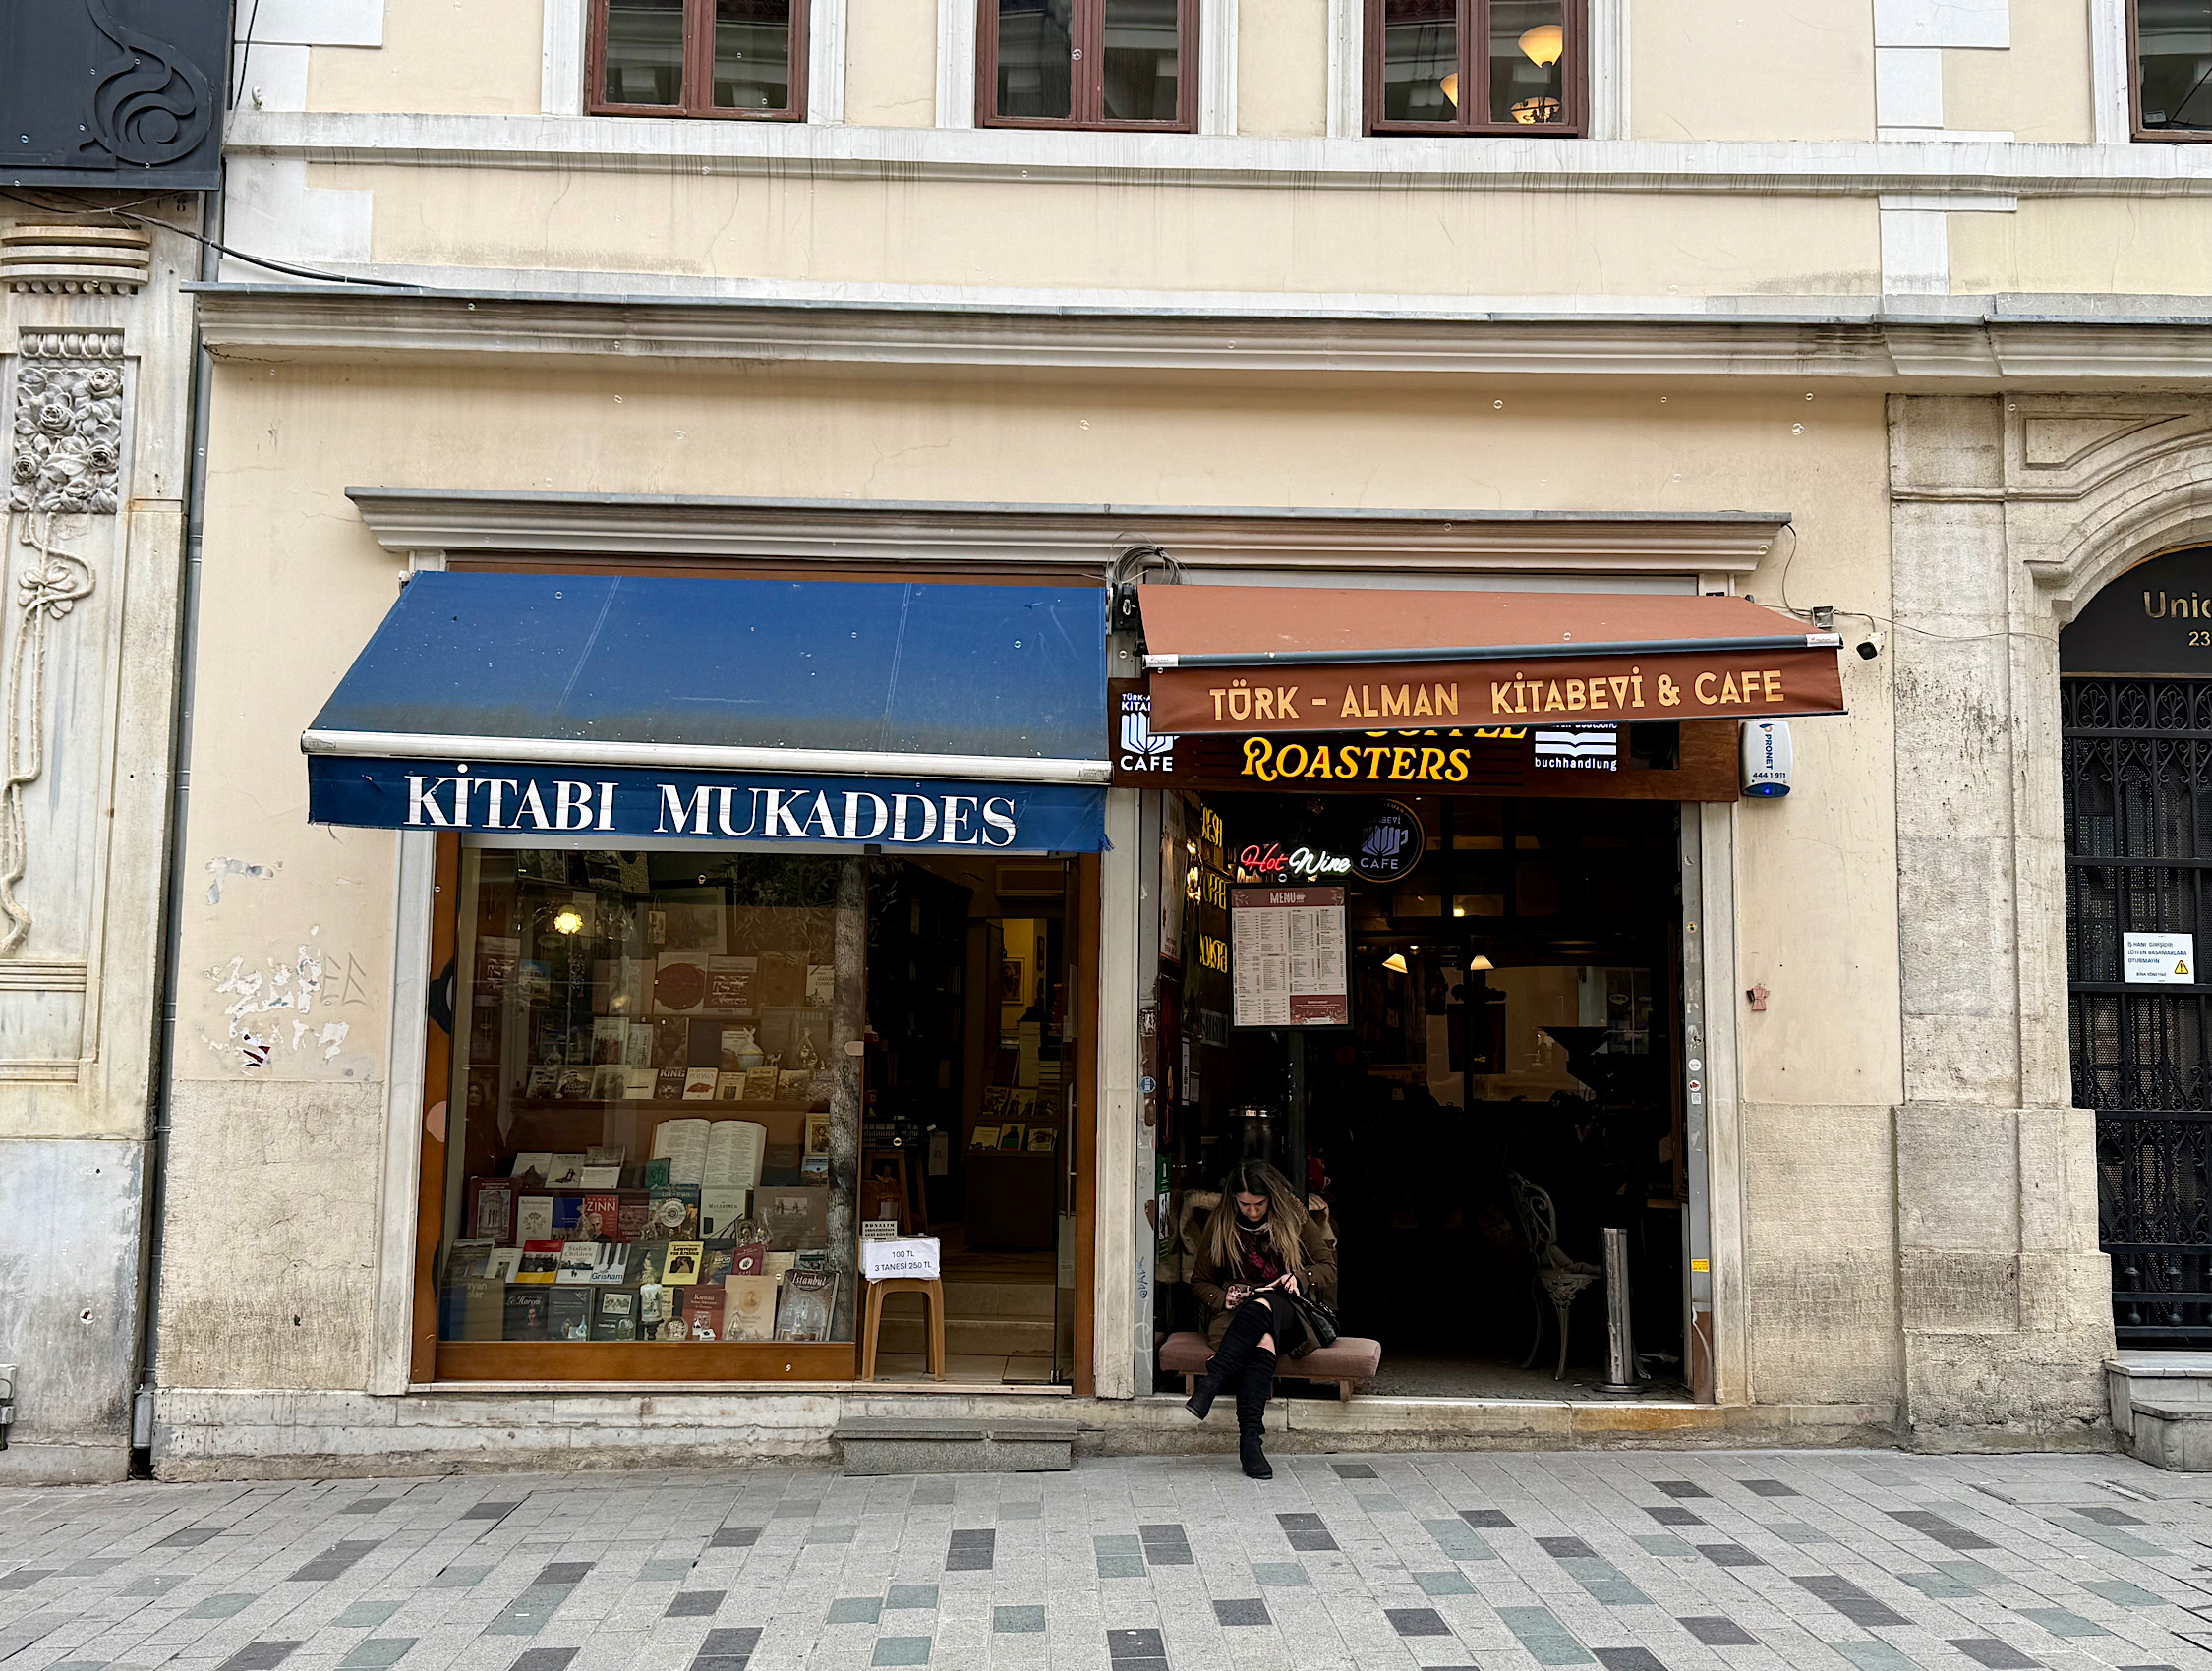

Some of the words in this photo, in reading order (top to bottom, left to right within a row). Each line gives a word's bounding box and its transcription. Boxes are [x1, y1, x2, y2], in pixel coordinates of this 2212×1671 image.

[2188, 631, 2212, 646] 23
[1209, 678, 1300, 720] TÜRK
[1340, 683, 1459, 718] ALMAN
[1490, 665, 1644, 715] KİTABEVİ
[1657, 673, 1681, 707] &
[1694, 669, 1784, 705] CAFE
[1122, 701, 1151, 711] KİTA
[1121, 755, 1173, 772] CAFE
[1241, 736, 1471, 782] ROASTERS
[1535, 757, 1617, 772] buchhandlung
[404, 764, 619, 833] KİTABI
[653, 781, 1017, 848] MUKADDES
[1241, 842, 1289, 873] Hot
[1289, 847, 1351, 874] Wine
[1361, 857, 1399, 870] CAFE
[1269, 892, 1297, 904] MENU
[659, 1068, 686, 1078] KING
[587, 1201, 616, 1212] ZINN
[881, 1261, 907, 1271] TANESİ
